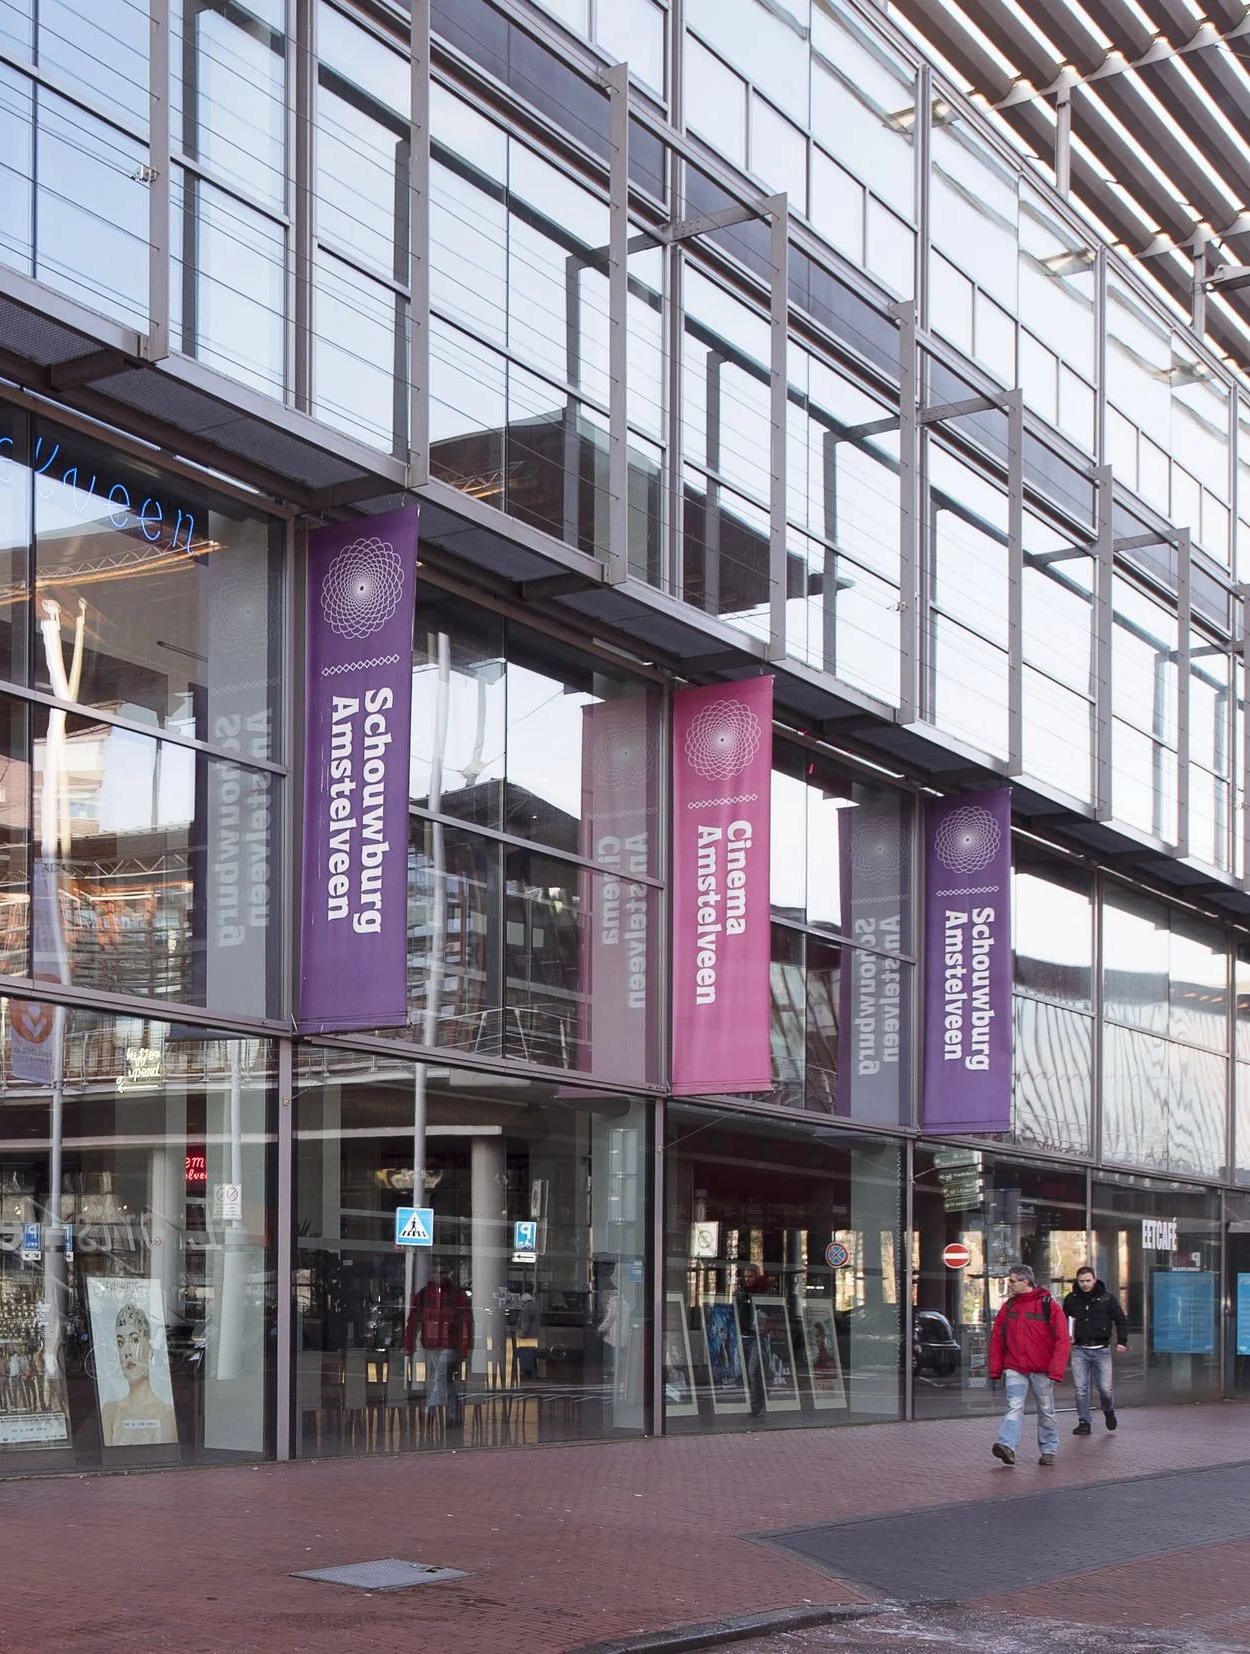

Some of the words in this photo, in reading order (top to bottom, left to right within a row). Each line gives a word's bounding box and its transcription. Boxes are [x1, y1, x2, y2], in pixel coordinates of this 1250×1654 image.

[327, 695, 360, 922] Amstelveen
[352, 686, 394, 935] Schouwburg
[725, 819, 753, 936] Cinema
[695, 825, 723, 1006] Amstelveen
[943, 909, 969, 1061] Amstelveen
[964, 906, 996, 1071] Schouwburg
[1141, 1217, 1178, 1251] EETCAFÉ
